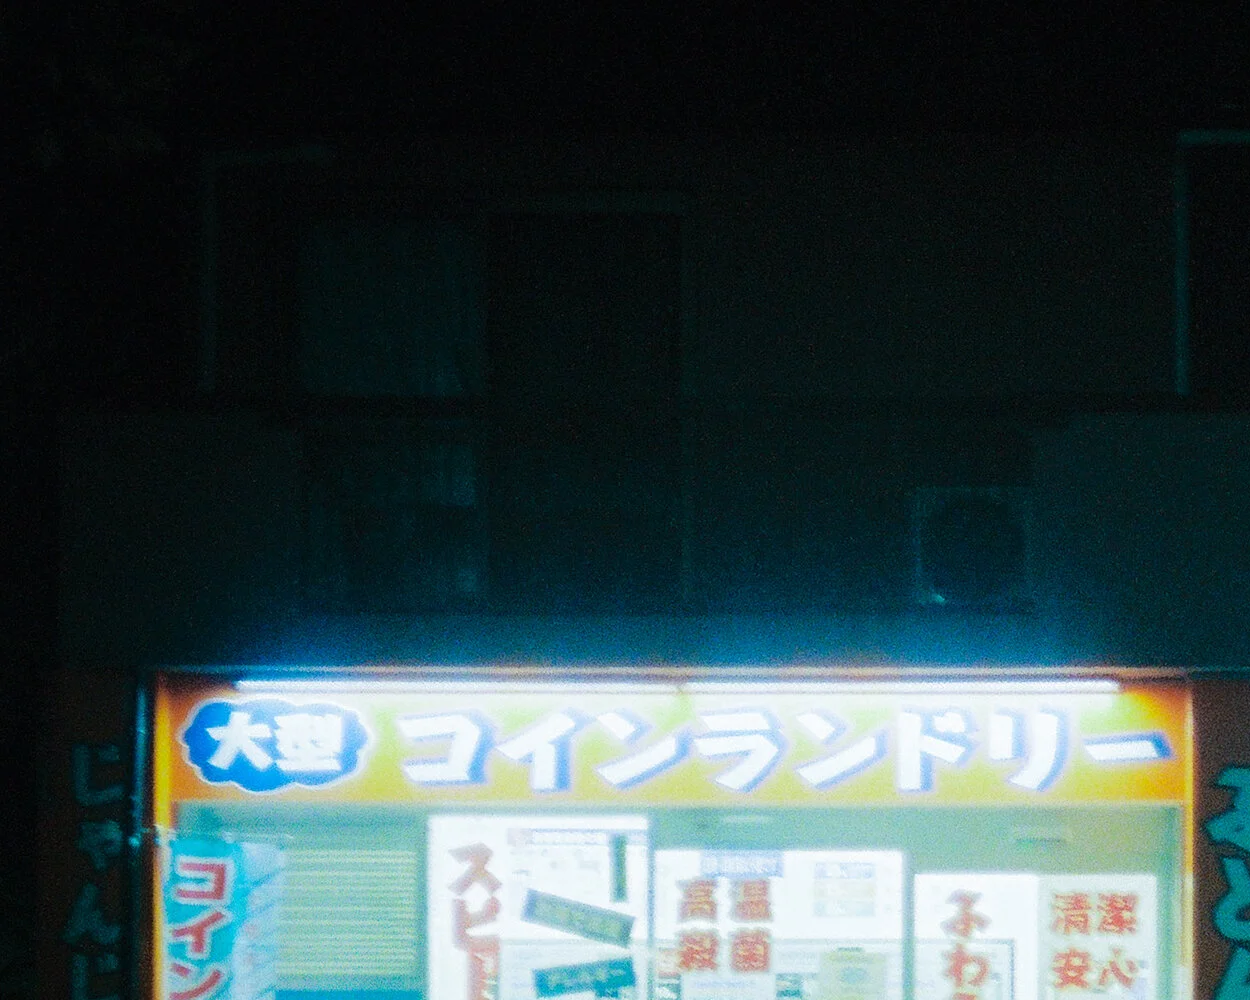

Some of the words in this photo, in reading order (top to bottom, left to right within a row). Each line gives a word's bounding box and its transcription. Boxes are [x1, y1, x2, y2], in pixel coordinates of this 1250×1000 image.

[205, 711, 344, 772] 大型
[398, 708, 1173, 793] コインランドリー
[1050, 891, 1140, 936] 清潔
[1052, 946, 1141, 990] 安心
